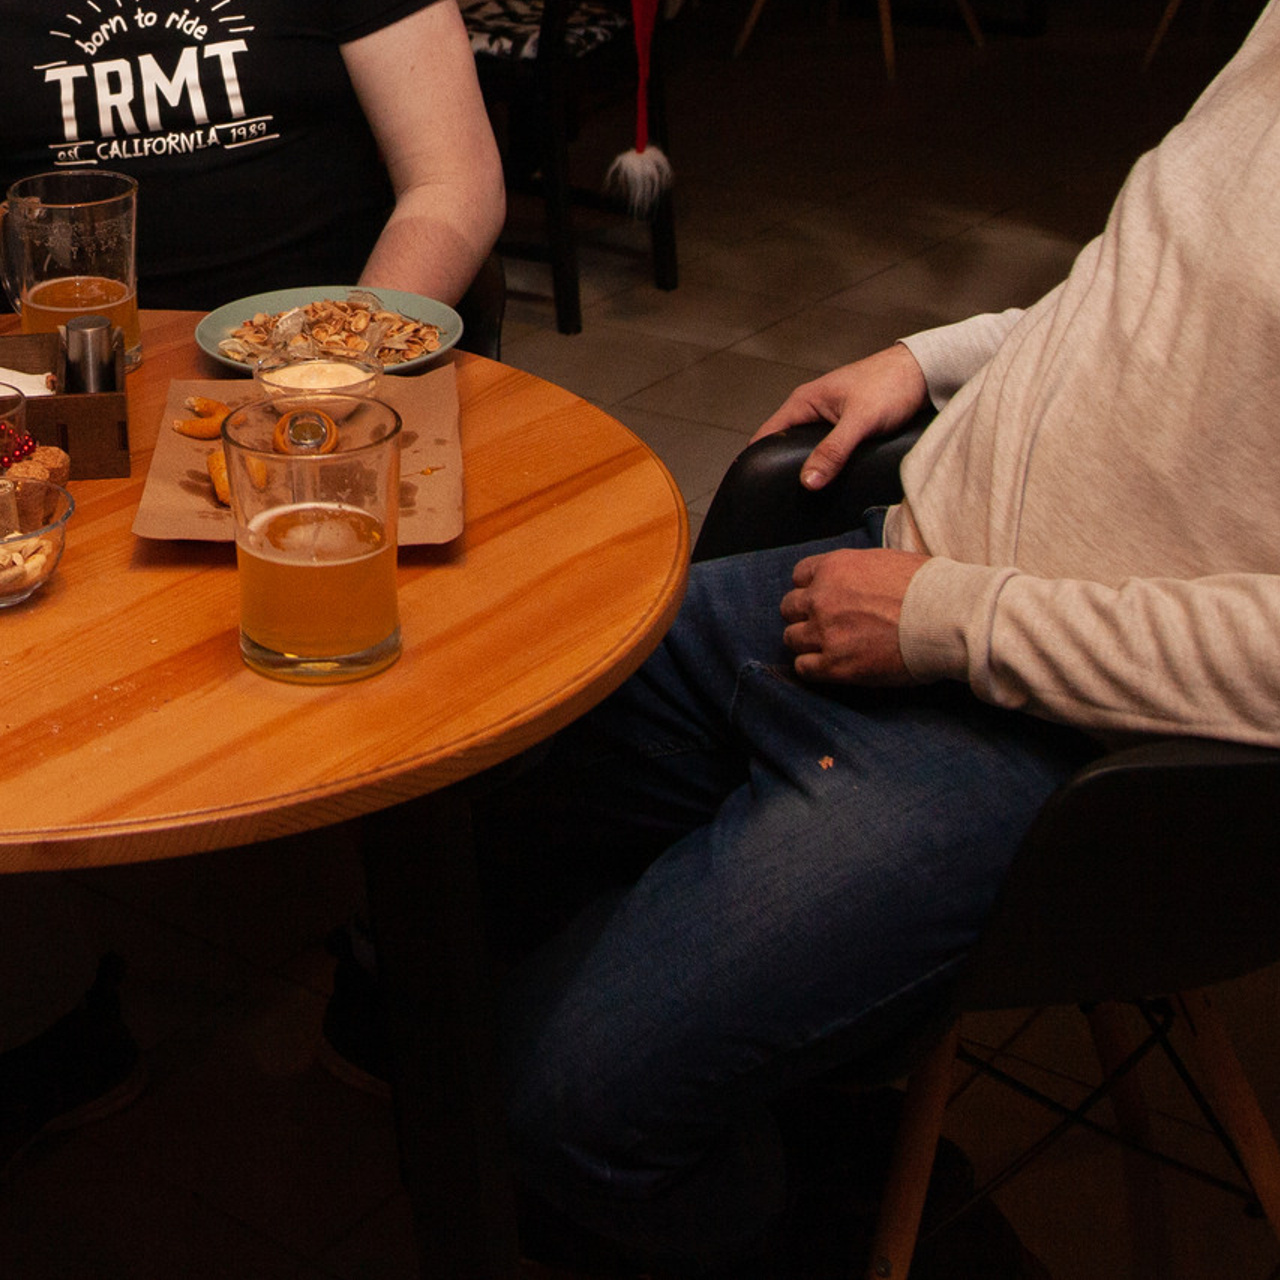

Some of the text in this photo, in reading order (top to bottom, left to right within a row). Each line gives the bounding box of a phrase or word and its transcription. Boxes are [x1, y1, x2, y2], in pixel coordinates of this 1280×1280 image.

[74, 6, 208, 56] born to ride
[44, 38, 249, 142] TRMT
[96, 127, 220, 161] CALIFORNIA
[229, 122, 267, 142] 1989
